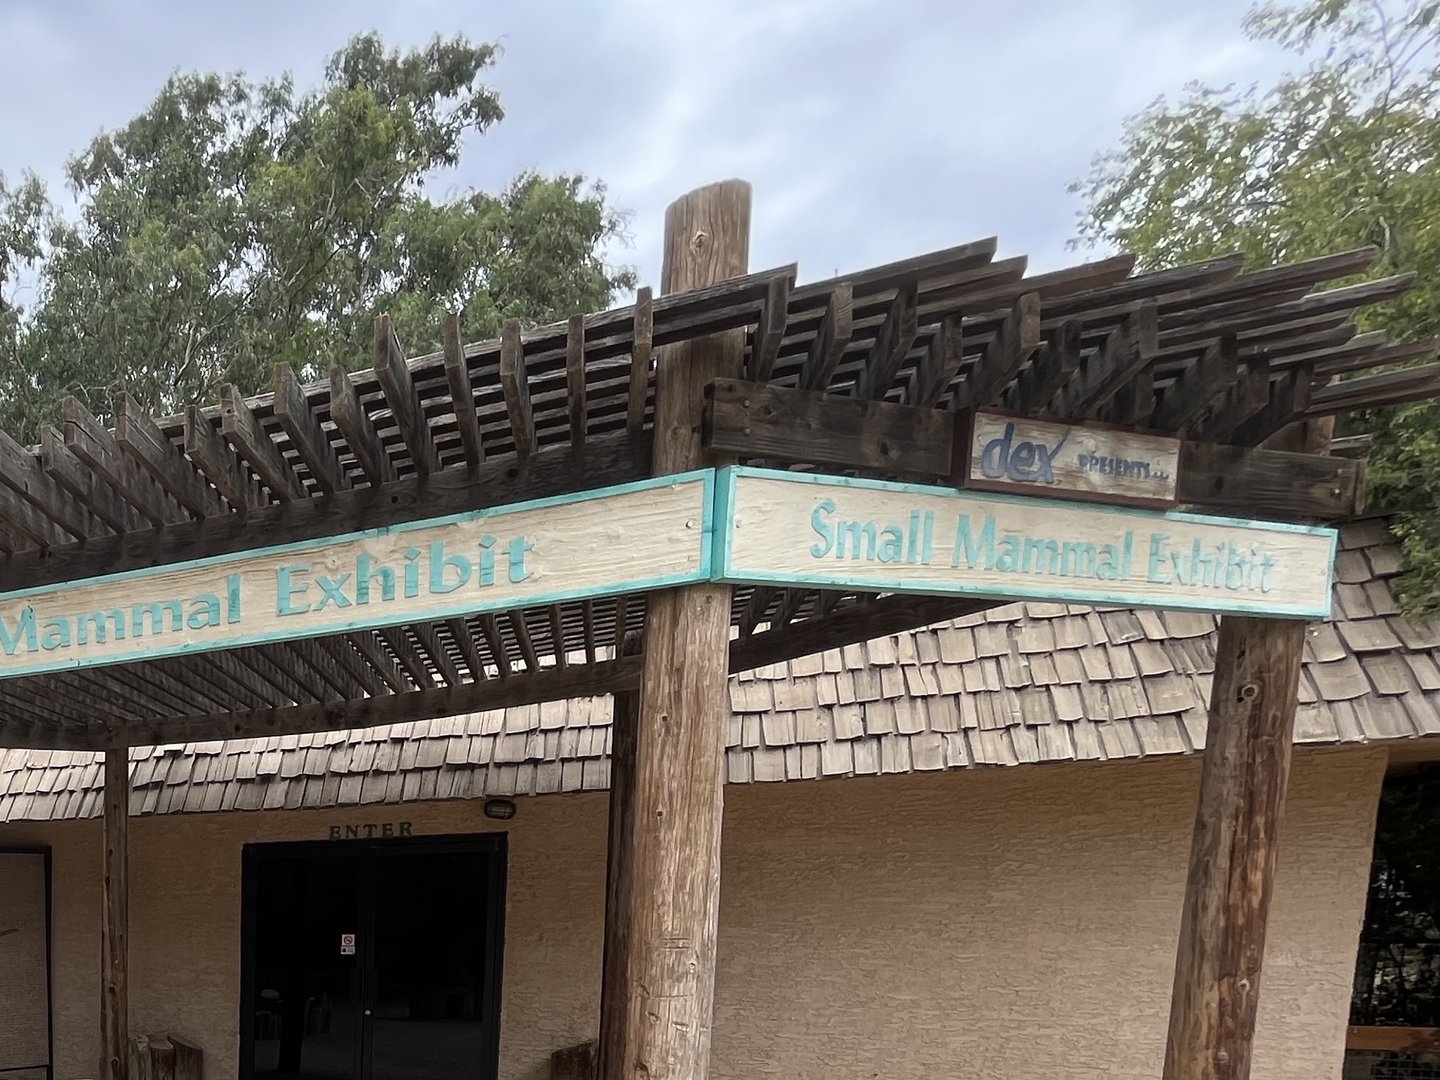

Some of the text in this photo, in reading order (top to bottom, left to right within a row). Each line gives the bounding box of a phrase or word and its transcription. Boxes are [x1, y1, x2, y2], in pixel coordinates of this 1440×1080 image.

[982, 422, 1071, 484] dex
[277, 534, 533, 616] Exhibit
[809, 499, 1276, 594] Small Mammal Exhibit
[330, 822, 413, 840] ENTER
